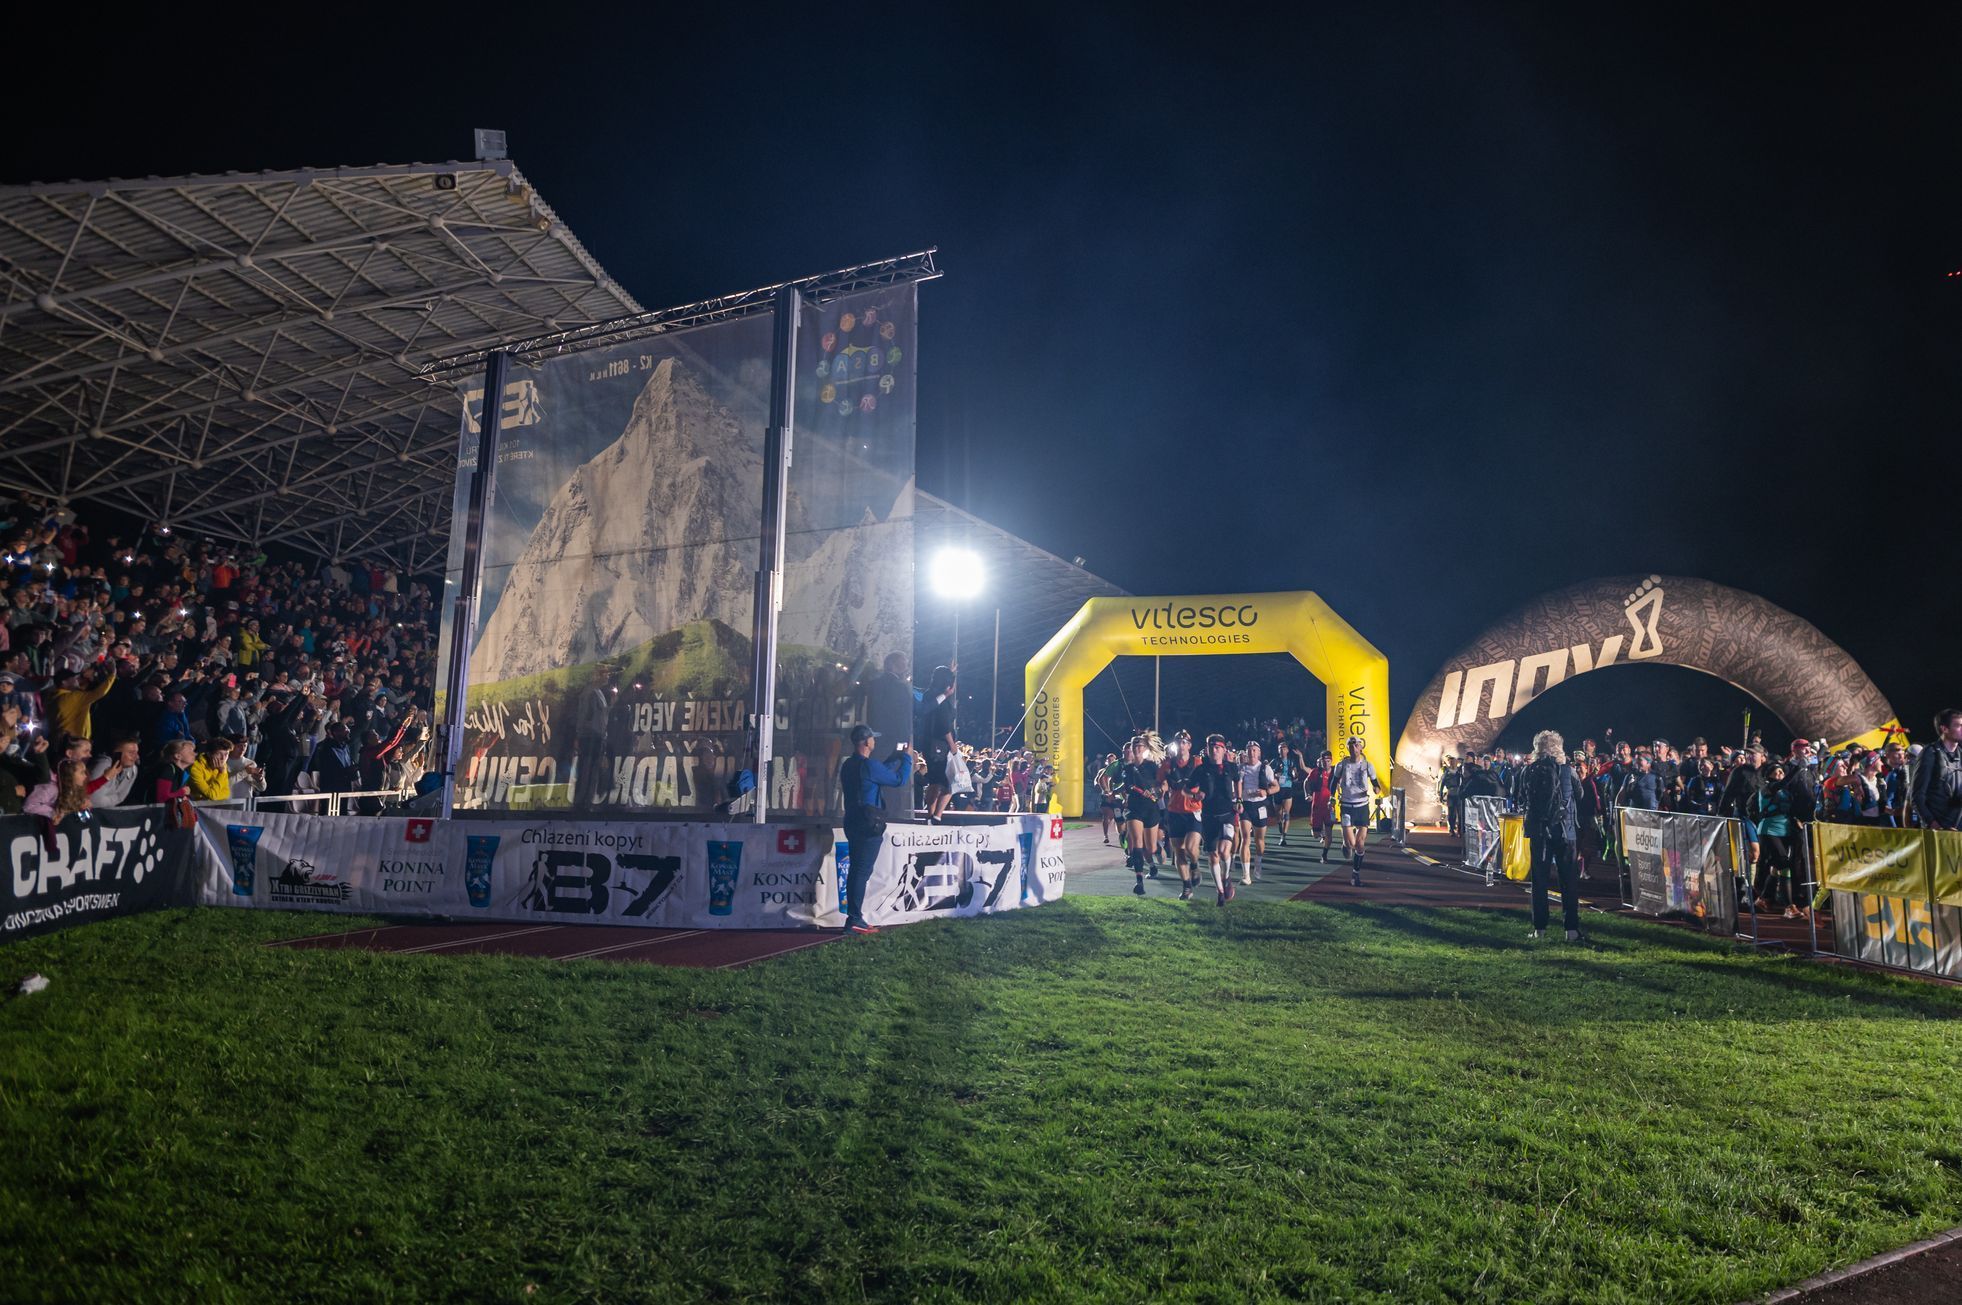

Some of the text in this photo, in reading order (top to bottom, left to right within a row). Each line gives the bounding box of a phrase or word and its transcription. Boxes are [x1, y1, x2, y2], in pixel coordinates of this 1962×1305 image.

[1131, 602, 1258, 630] vitesco
[1142, 634, 1250, 645] TECHNOLOGIES
[1032, 690, 1048, 759] tesco
[521, 828, 643, 851] Chlazení kopyt
[11, 826, 141, 897] CRAFT
[379, 860, 444, 875] KONINA
[383, 879, 436, 893] POINT
[753, 872, 824, 886] KONINA
[760, 891, 817, 905] POINT
